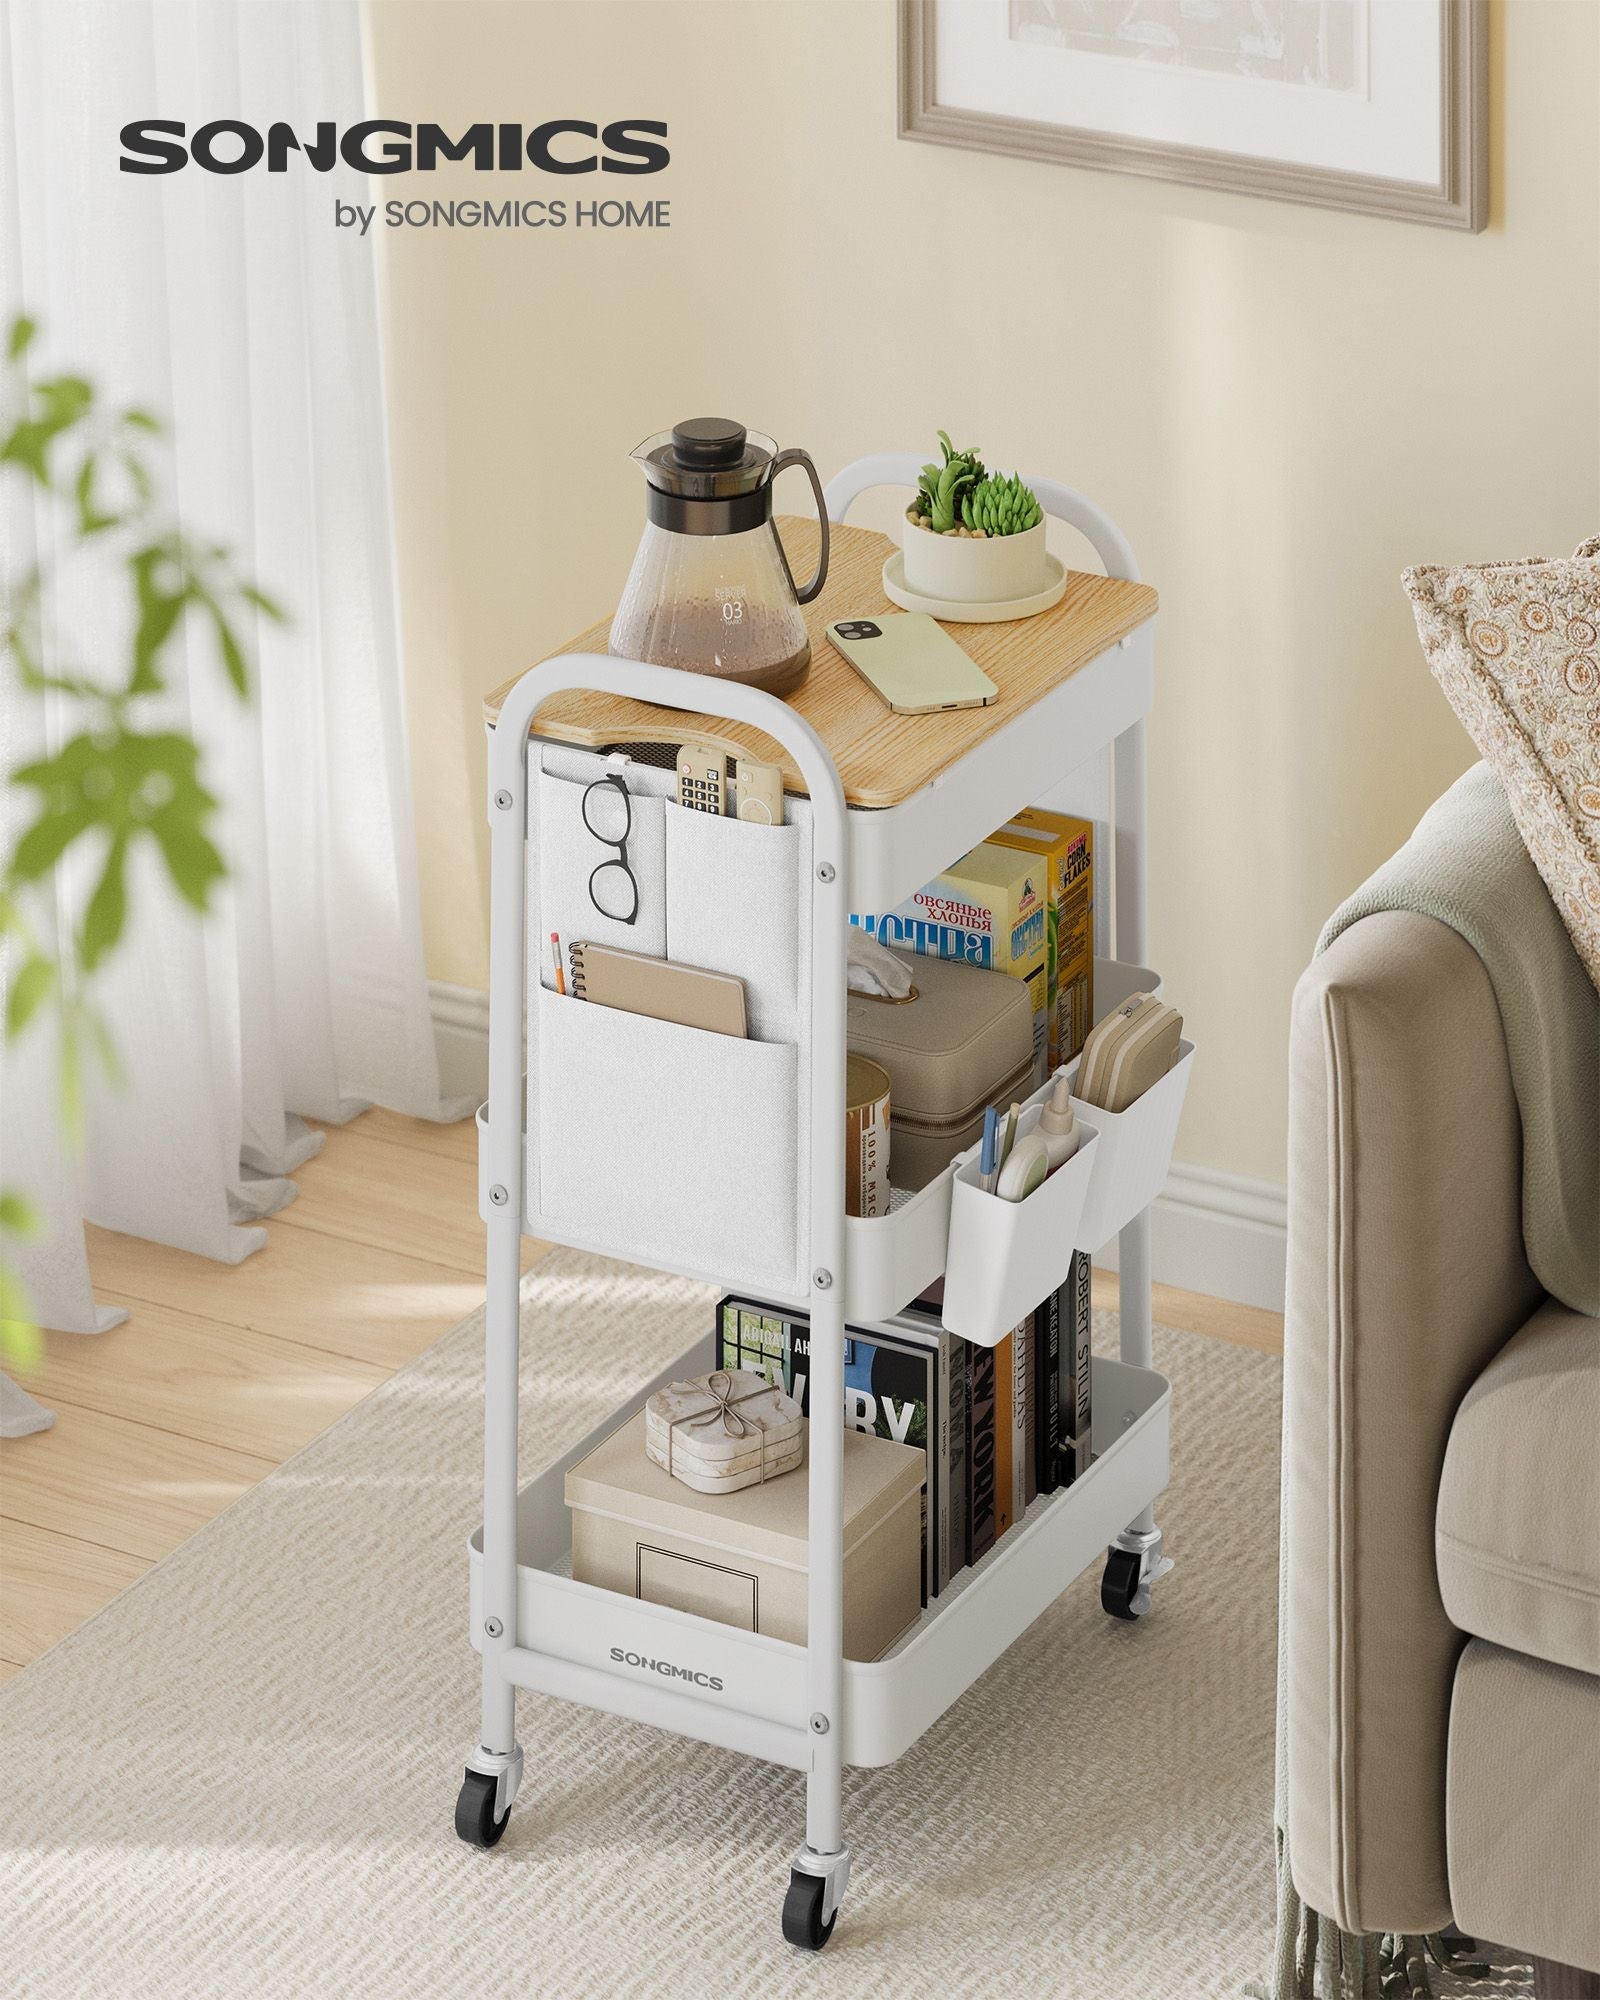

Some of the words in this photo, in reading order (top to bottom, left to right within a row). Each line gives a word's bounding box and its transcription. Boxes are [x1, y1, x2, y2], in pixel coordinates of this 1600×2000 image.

[722, 602, 743, 620] 03
[1064, 852, 1091, 888] FLAKES
[1067, 841, 1086, 870] CORN
[867, 1130, 877, 1172] 100%
[867, 1181, 877, 1217] МЯС
[1078, 1252, 1088, 1336] ROBERT
[743, 1326, 792, 1351] ABIGAIL
[1049, 1313, 1058, 1358] KEATON
[1078, 1343, 1088, 1419] STILIN
[1049, 1402, 1059, 1449] BUILT
[974, 1402, 994, 1535] YORK
[610, 1647, 724, 1691] SONGMICS
